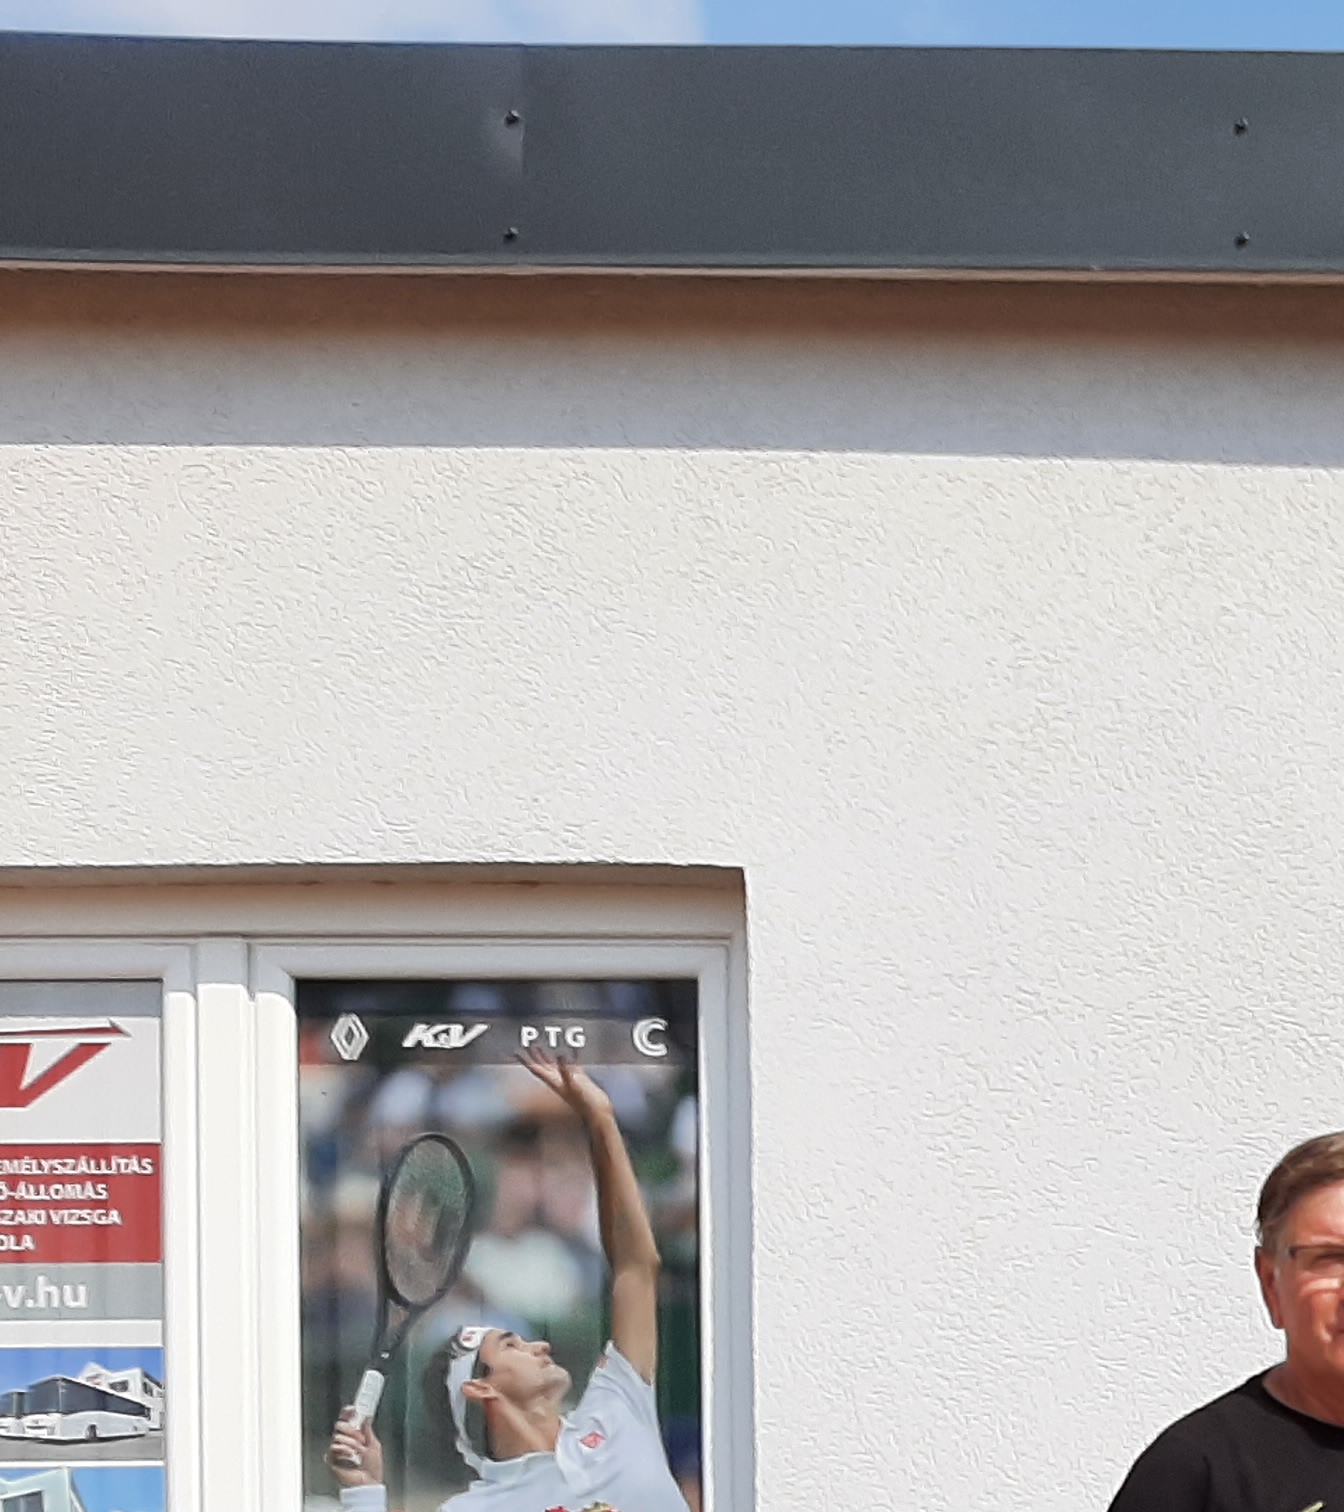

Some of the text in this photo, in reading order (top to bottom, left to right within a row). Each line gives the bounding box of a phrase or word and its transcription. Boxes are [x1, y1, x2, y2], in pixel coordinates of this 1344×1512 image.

[520, 1025, 586, 1048] PTG
[49, 1208, 122, 1225] VIZSGA
[0, 1275, 88, 1308] v.hu
